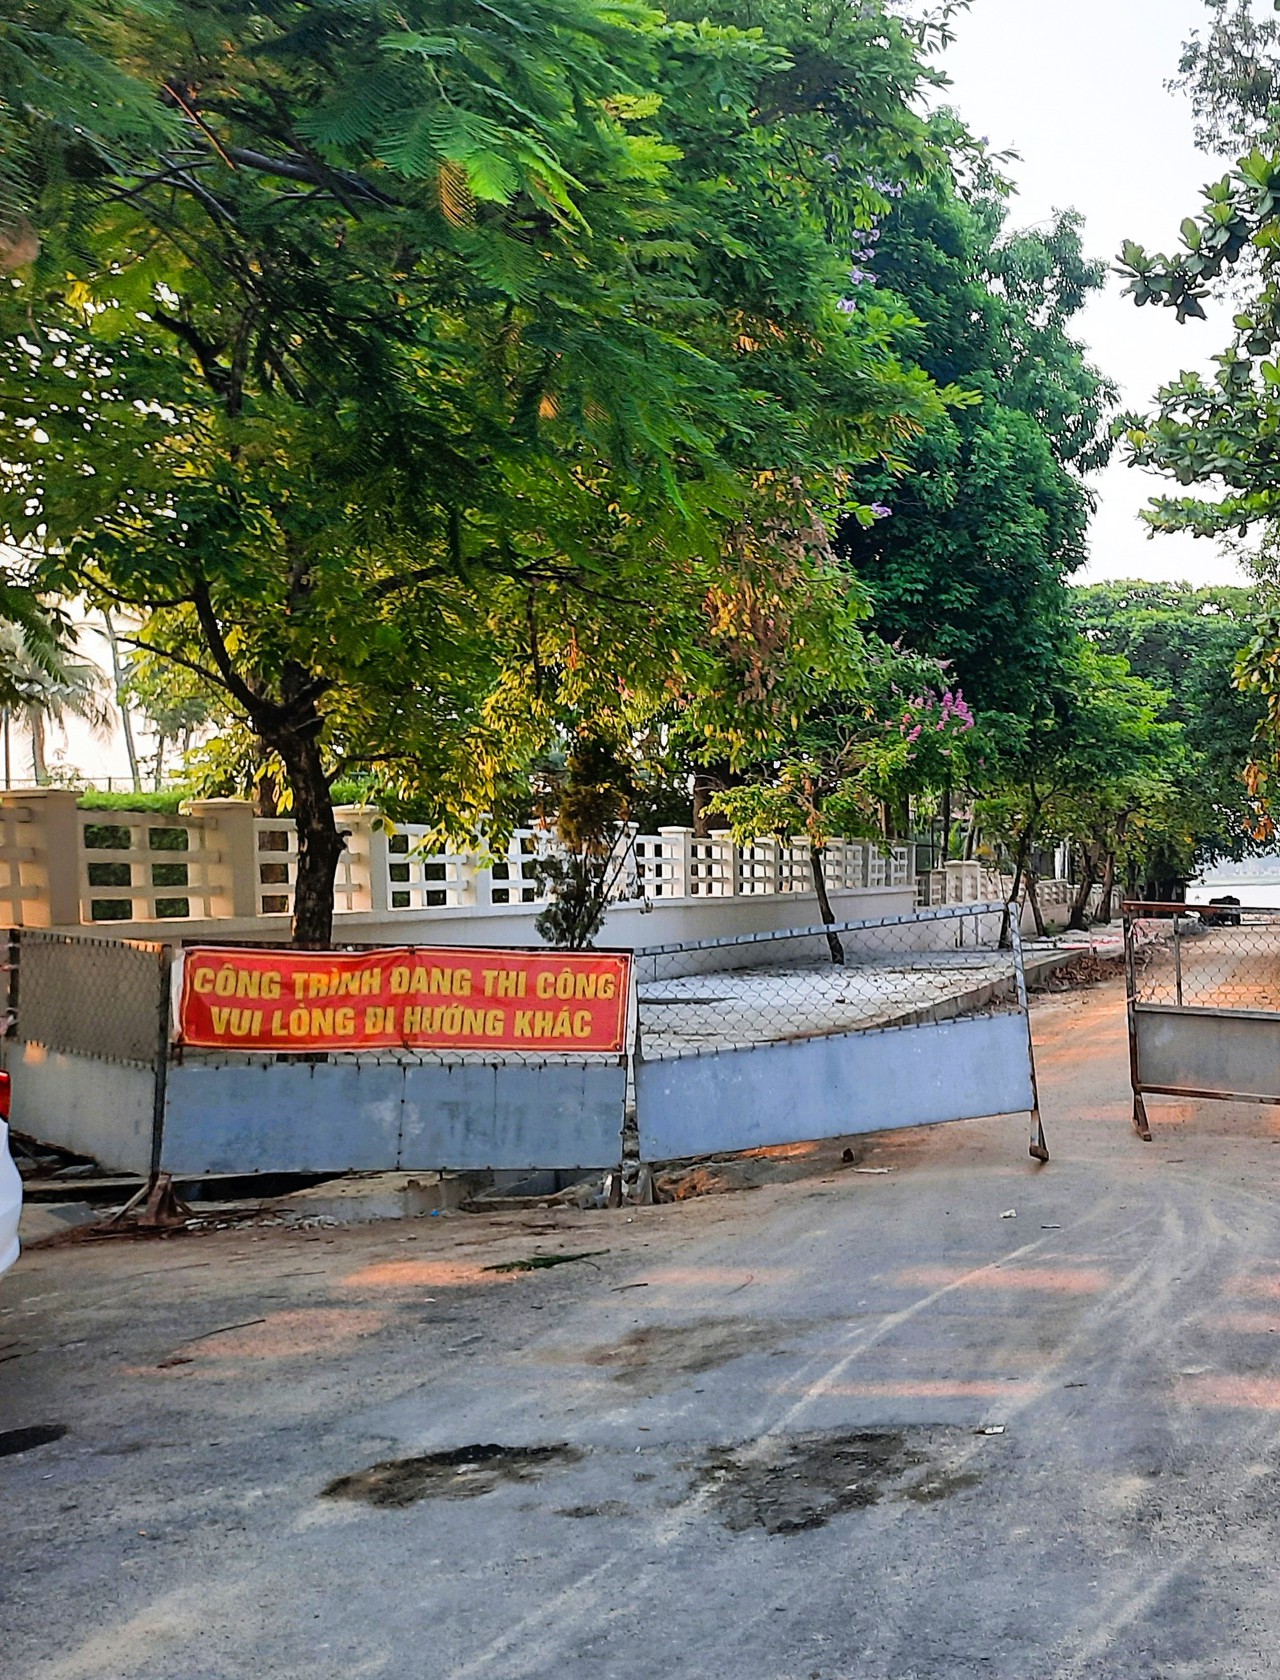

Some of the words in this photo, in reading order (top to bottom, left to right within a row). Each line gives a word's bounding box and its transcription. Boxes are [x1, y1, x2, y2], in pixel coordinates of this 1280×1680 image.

[193, 962, 281, 1000] CÔNG
[292, 967, 381, 1000] TRÌNH
[390, 966, 472, 996] ĐANG
[482, 969, 527, 998] THI
[536, 967, 616, 1000] CÔNG
[210, 1006, 263, 1036] VUI
[272, 1002, 355, 1037] LÒNG
[365, 1006, 395, 1035] ĐI
[403, 1003, 504, 1037] HƯỚNG
[514, 1006, 592, 1038] KHÁC
